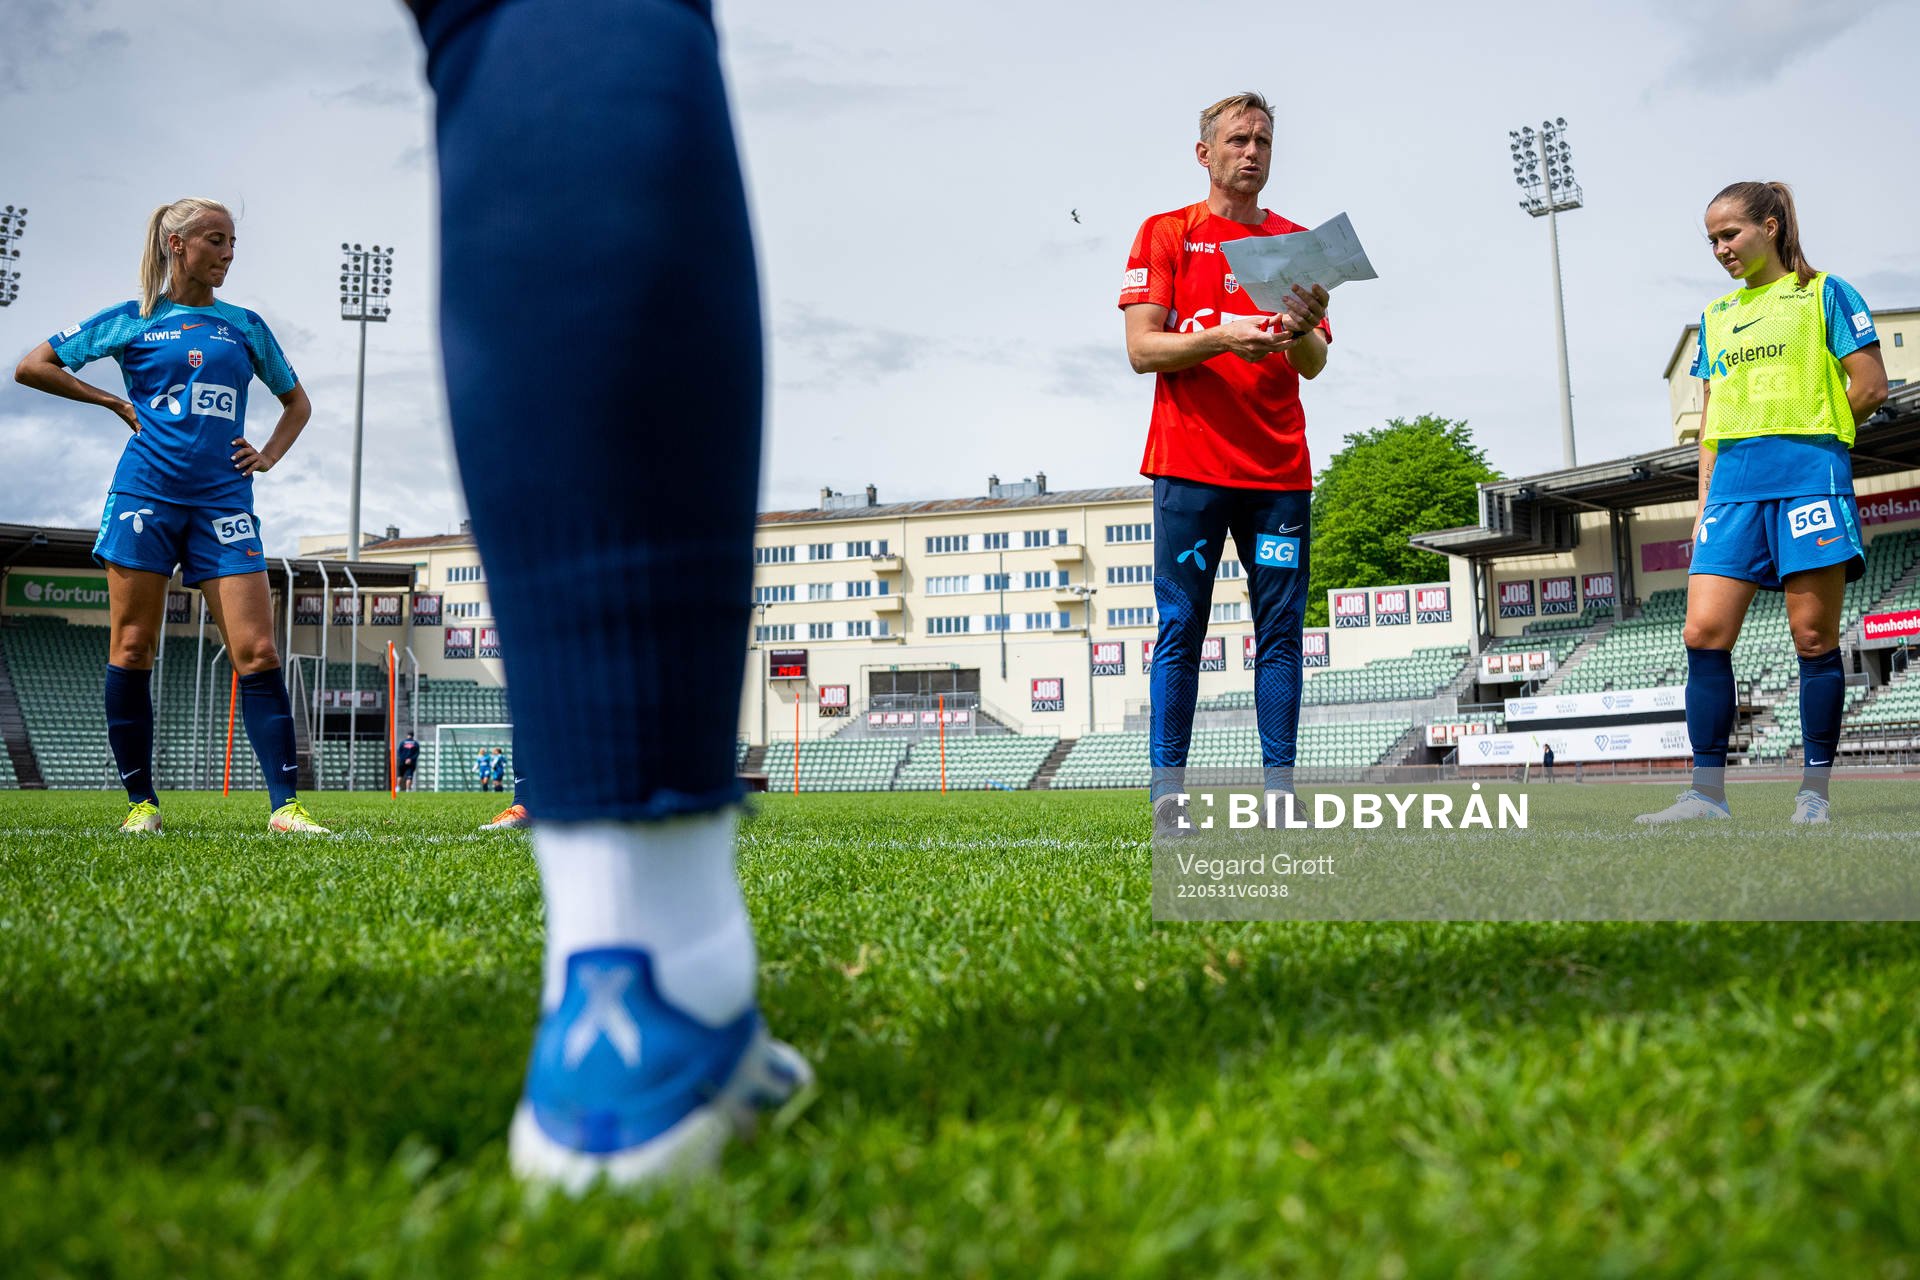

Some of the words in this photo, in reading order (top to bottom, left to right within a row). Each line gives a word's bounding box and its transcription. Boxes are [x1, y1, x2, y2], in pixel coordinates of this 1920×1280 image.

[144, 331, 170, 341] KIWI
[1726, 343, 1786, 367] telenor
[197, 390, 233, 413] 5G
[1795, 507, 1827, 531] 5G
[222, 519, 250, 538] 5G
[1260, 541, 1295, 562] 5G
[1502, 584, 1528, 603] JOB
[1544, 581, 1571, 601] JOB
[1586, 576, 1613, 596] JOB
[374, 597, 398, 613] JOB
[414, 598, 437, 613] JOB
[1337, 596, 1363, 614] JOB
[1378, 594, 1404, 612] JOB
[1418, 591, 1444, 609] JOB
[1542, 602, 1577, 613] ZONE
[1377, 613, 1410, 624] ZONE
[1417, 611, 1451, 622] ZONE
[1501, 605, 1535, 616] ZONE
[1336, 615, 1369, 626] ZONE
[447, 630, 471, 646] JOB
[446, 649, 474, 657] ZONE
[1095, 645, 1120, 661] JOB
[1304, 656, 1329, 666] ONE
[1093, 665, 1124, 674] ZONE
[1200, 660, 1225, 670] ONE
[821, 687, 845, 704] JOB
[1034, 681, 1059, 698] JOB
[1032, 701, 1063, 710] ZONE
